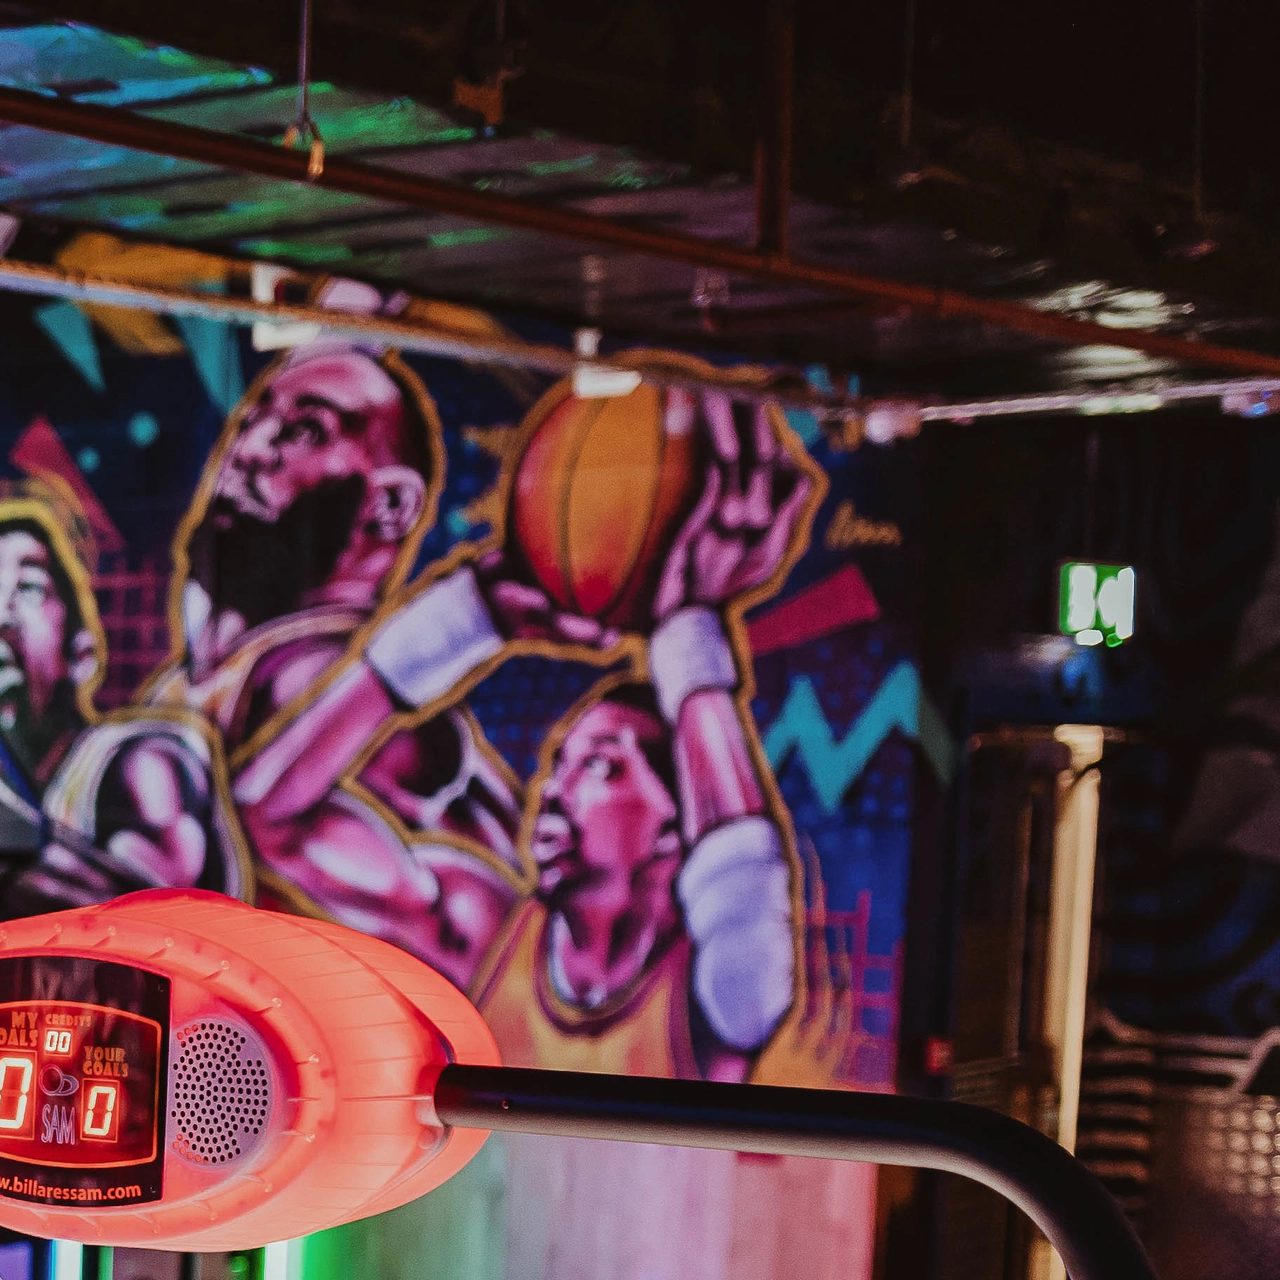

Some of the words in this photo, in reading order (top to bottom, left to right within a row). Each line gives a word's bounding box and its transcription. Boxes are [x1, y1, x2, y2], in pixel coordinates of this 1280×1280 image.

[11, 1011, 38, 1028] MY
[45, 1013, 92, 1027] CREDITS
[45, 1030, 71, 1053] 00
[83, 1045, 126, 1062] YOUR
[83, 1060, 129, 1078] GOALS
[84, 1086, 116, 1136] 0
[41, 1103, 76, 1145] SAM
